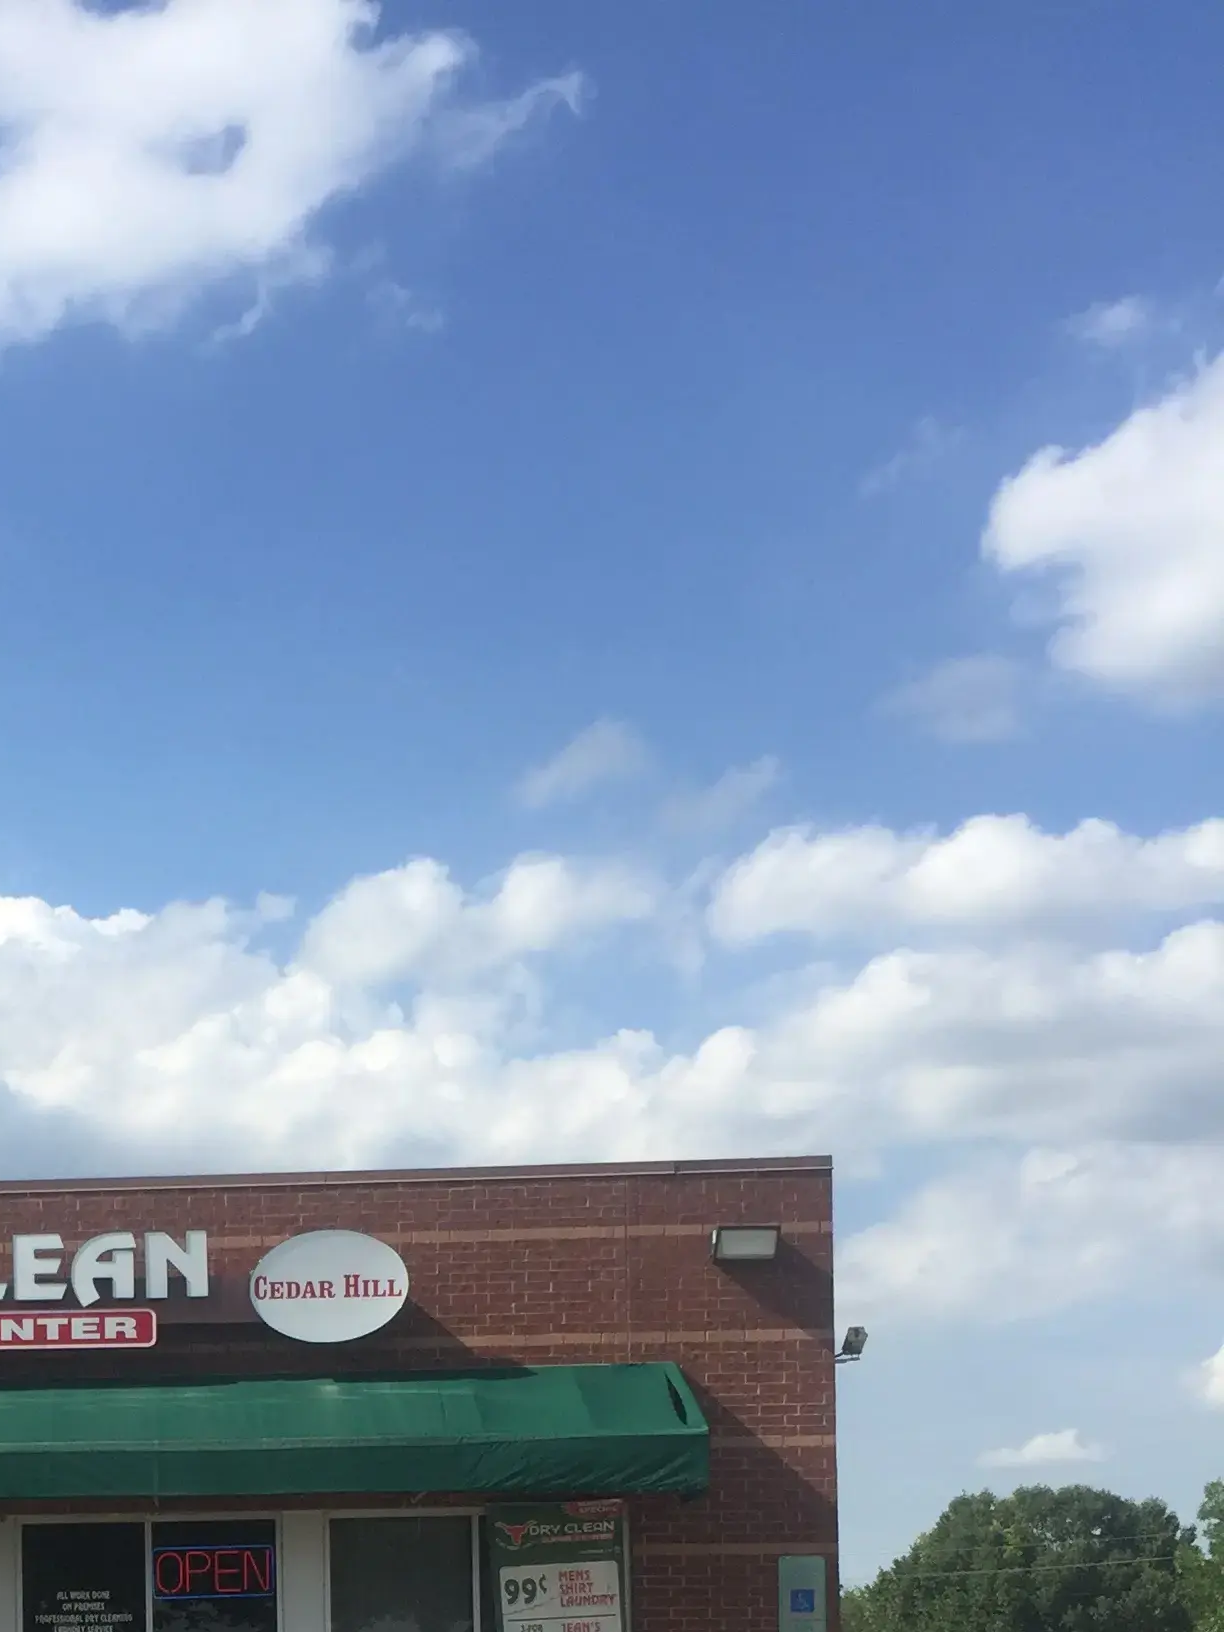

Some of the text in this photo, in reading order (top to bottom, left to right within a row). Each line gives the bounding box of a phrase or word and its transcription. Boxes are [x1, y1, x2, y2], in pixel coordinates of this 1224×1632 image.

[529, 1520, 615, 1536] DRY CLEAN
[155, 1549, 271, 1594] OPEN
[558, 1570, 591, 1582] MENS
[56, 1590, 111, 1600] ALL WORK DONE
[559, 1582, 594, 1595] SHIRT
[560, 1594, 617, 1607] LAUNDRY
